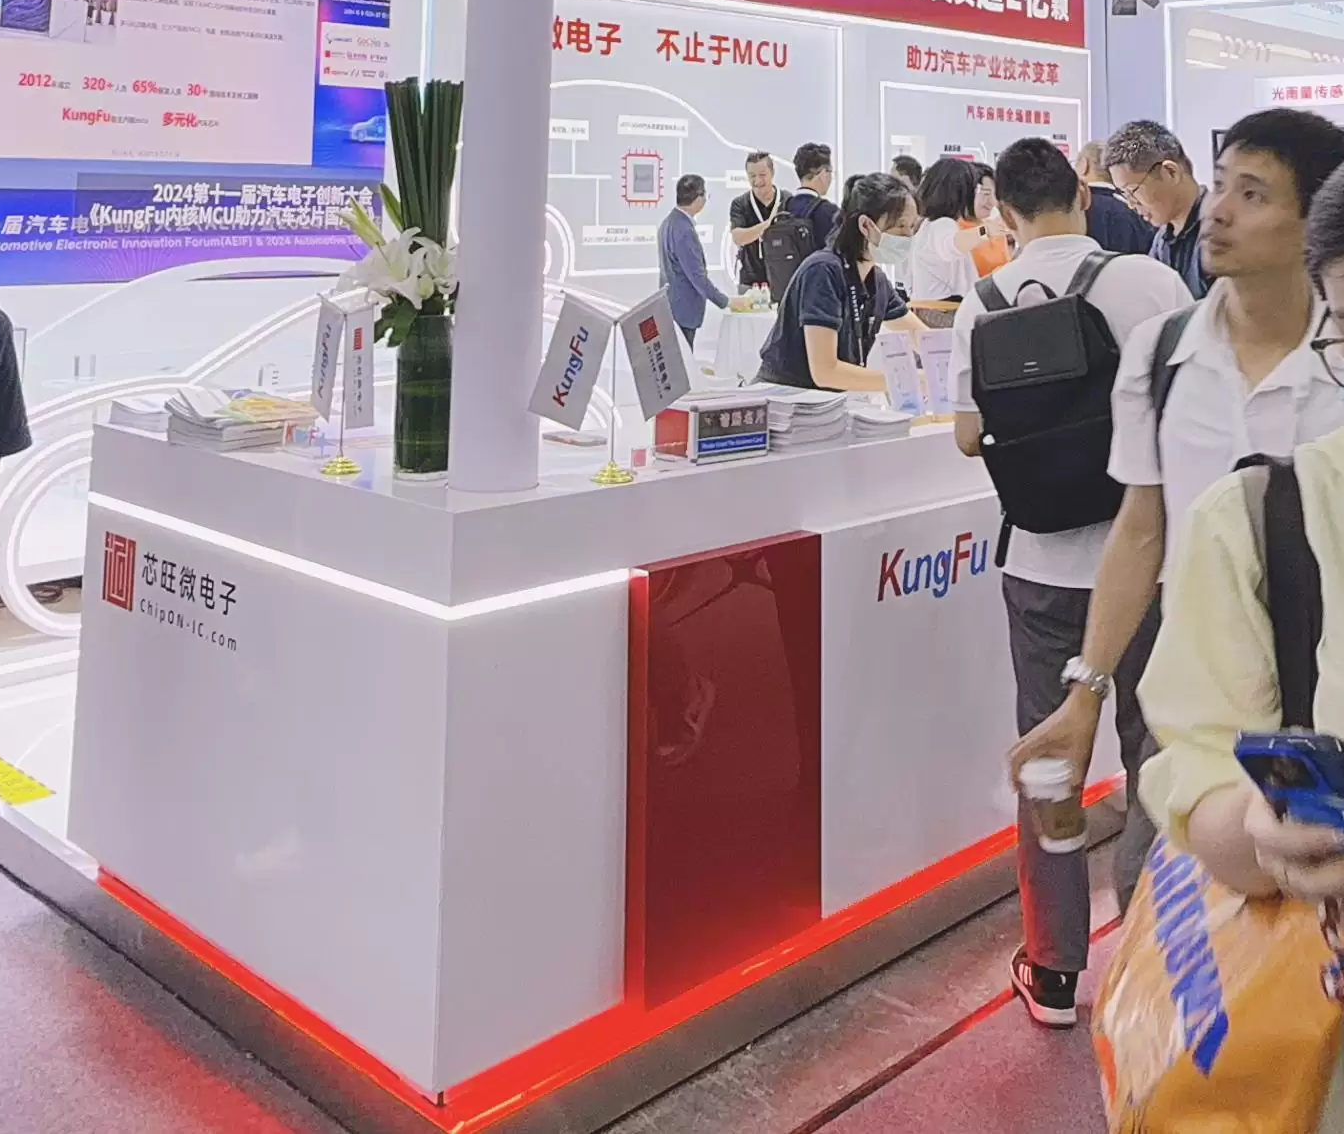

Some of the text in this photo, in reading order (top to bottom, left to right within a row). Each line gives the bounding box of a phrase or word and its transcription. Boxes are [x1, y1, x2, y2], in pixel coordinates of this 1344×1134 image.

[656, 28, 788, 68] 不止于MCU
[906, 44, 1061, 86] 助力汽车产业技术变革
[151, 182, 374, 207] 2024第十一届汽车电子创新大会
[88, 202, 375, 230] 《KungFu内核MCU助力汽车芯片国》
[56, 236, 118, 251] Electronic
[121, 235, 183, 249] Innovation
[184, 235, 253, 249] Forum(AEIF)
[266, 236, 291, 247] 2024
[551, 325, 591, 408] KungFu
[141, 551, 237, 617] 芯旺微电子
[877, 531, 989, 603] KungFu
[139, 598, 238, 652] ChipON-IC.com
